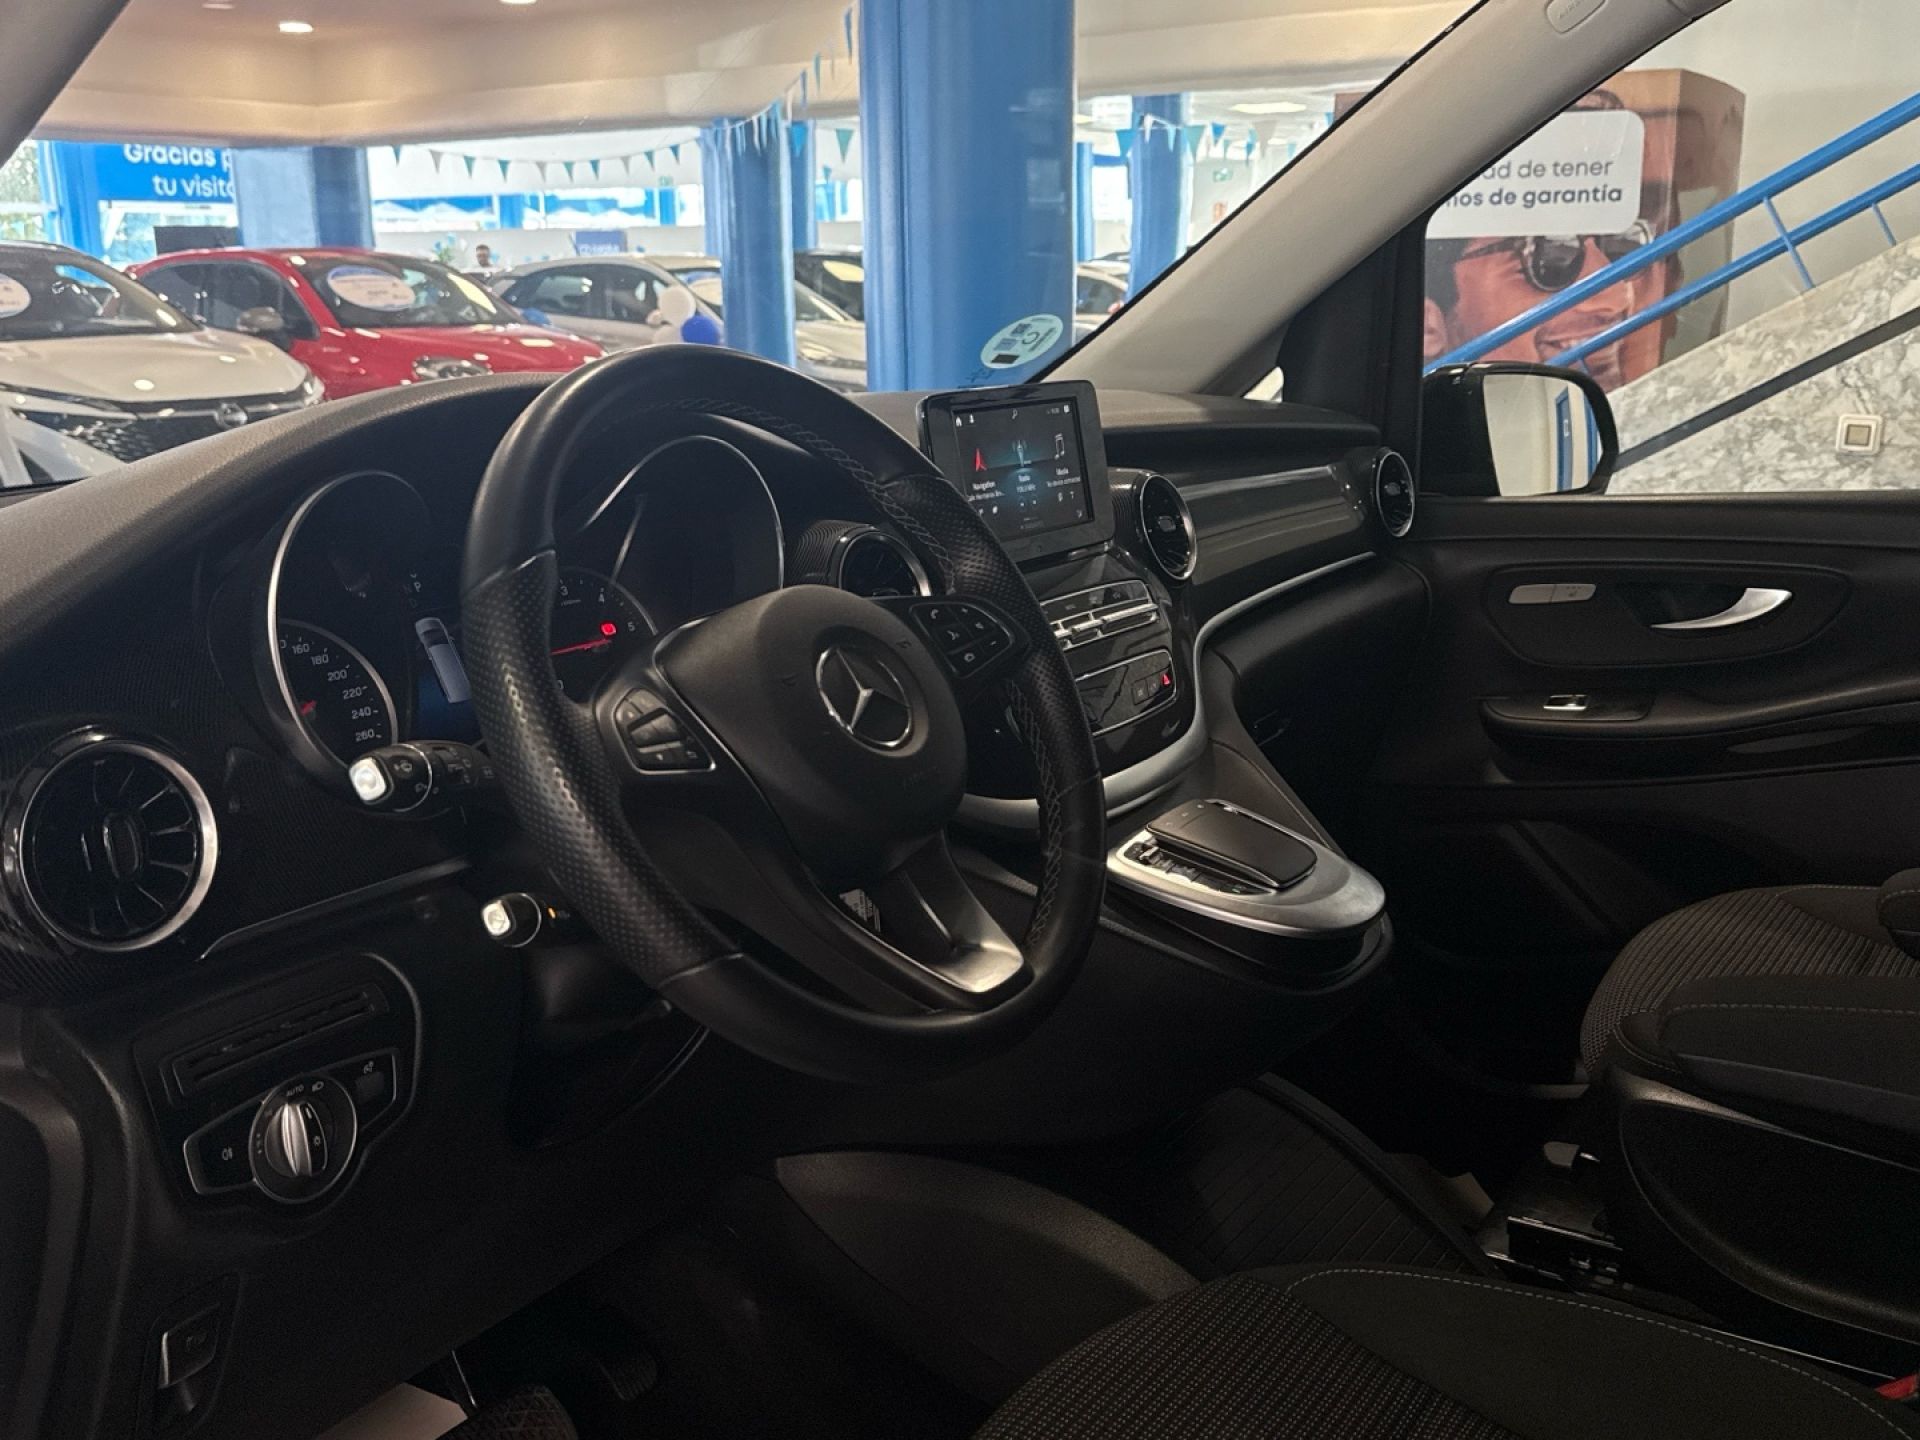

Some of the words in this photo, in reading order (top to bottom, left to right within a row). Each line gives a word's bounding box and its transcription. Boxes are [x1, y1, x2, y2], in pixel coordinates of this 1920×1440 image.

[123, 143, 217, 168] Gracias
[1518, 160, 1546, 179] de
[1552, 160, 1615, 178] tener
[152, 174, 178, 196] tu
[1488, 188, 1517, 206] de
[627, 621, 636, 632] 5
[291, 643, 310, 655] 160
[310, 653, 329, 666] 180
[327, 669, 348, 683] 200
[342, 686, 363, 700] 220
[351, 706, 372, 720] 240
[286, 1083, 305, 1097] AUTO
